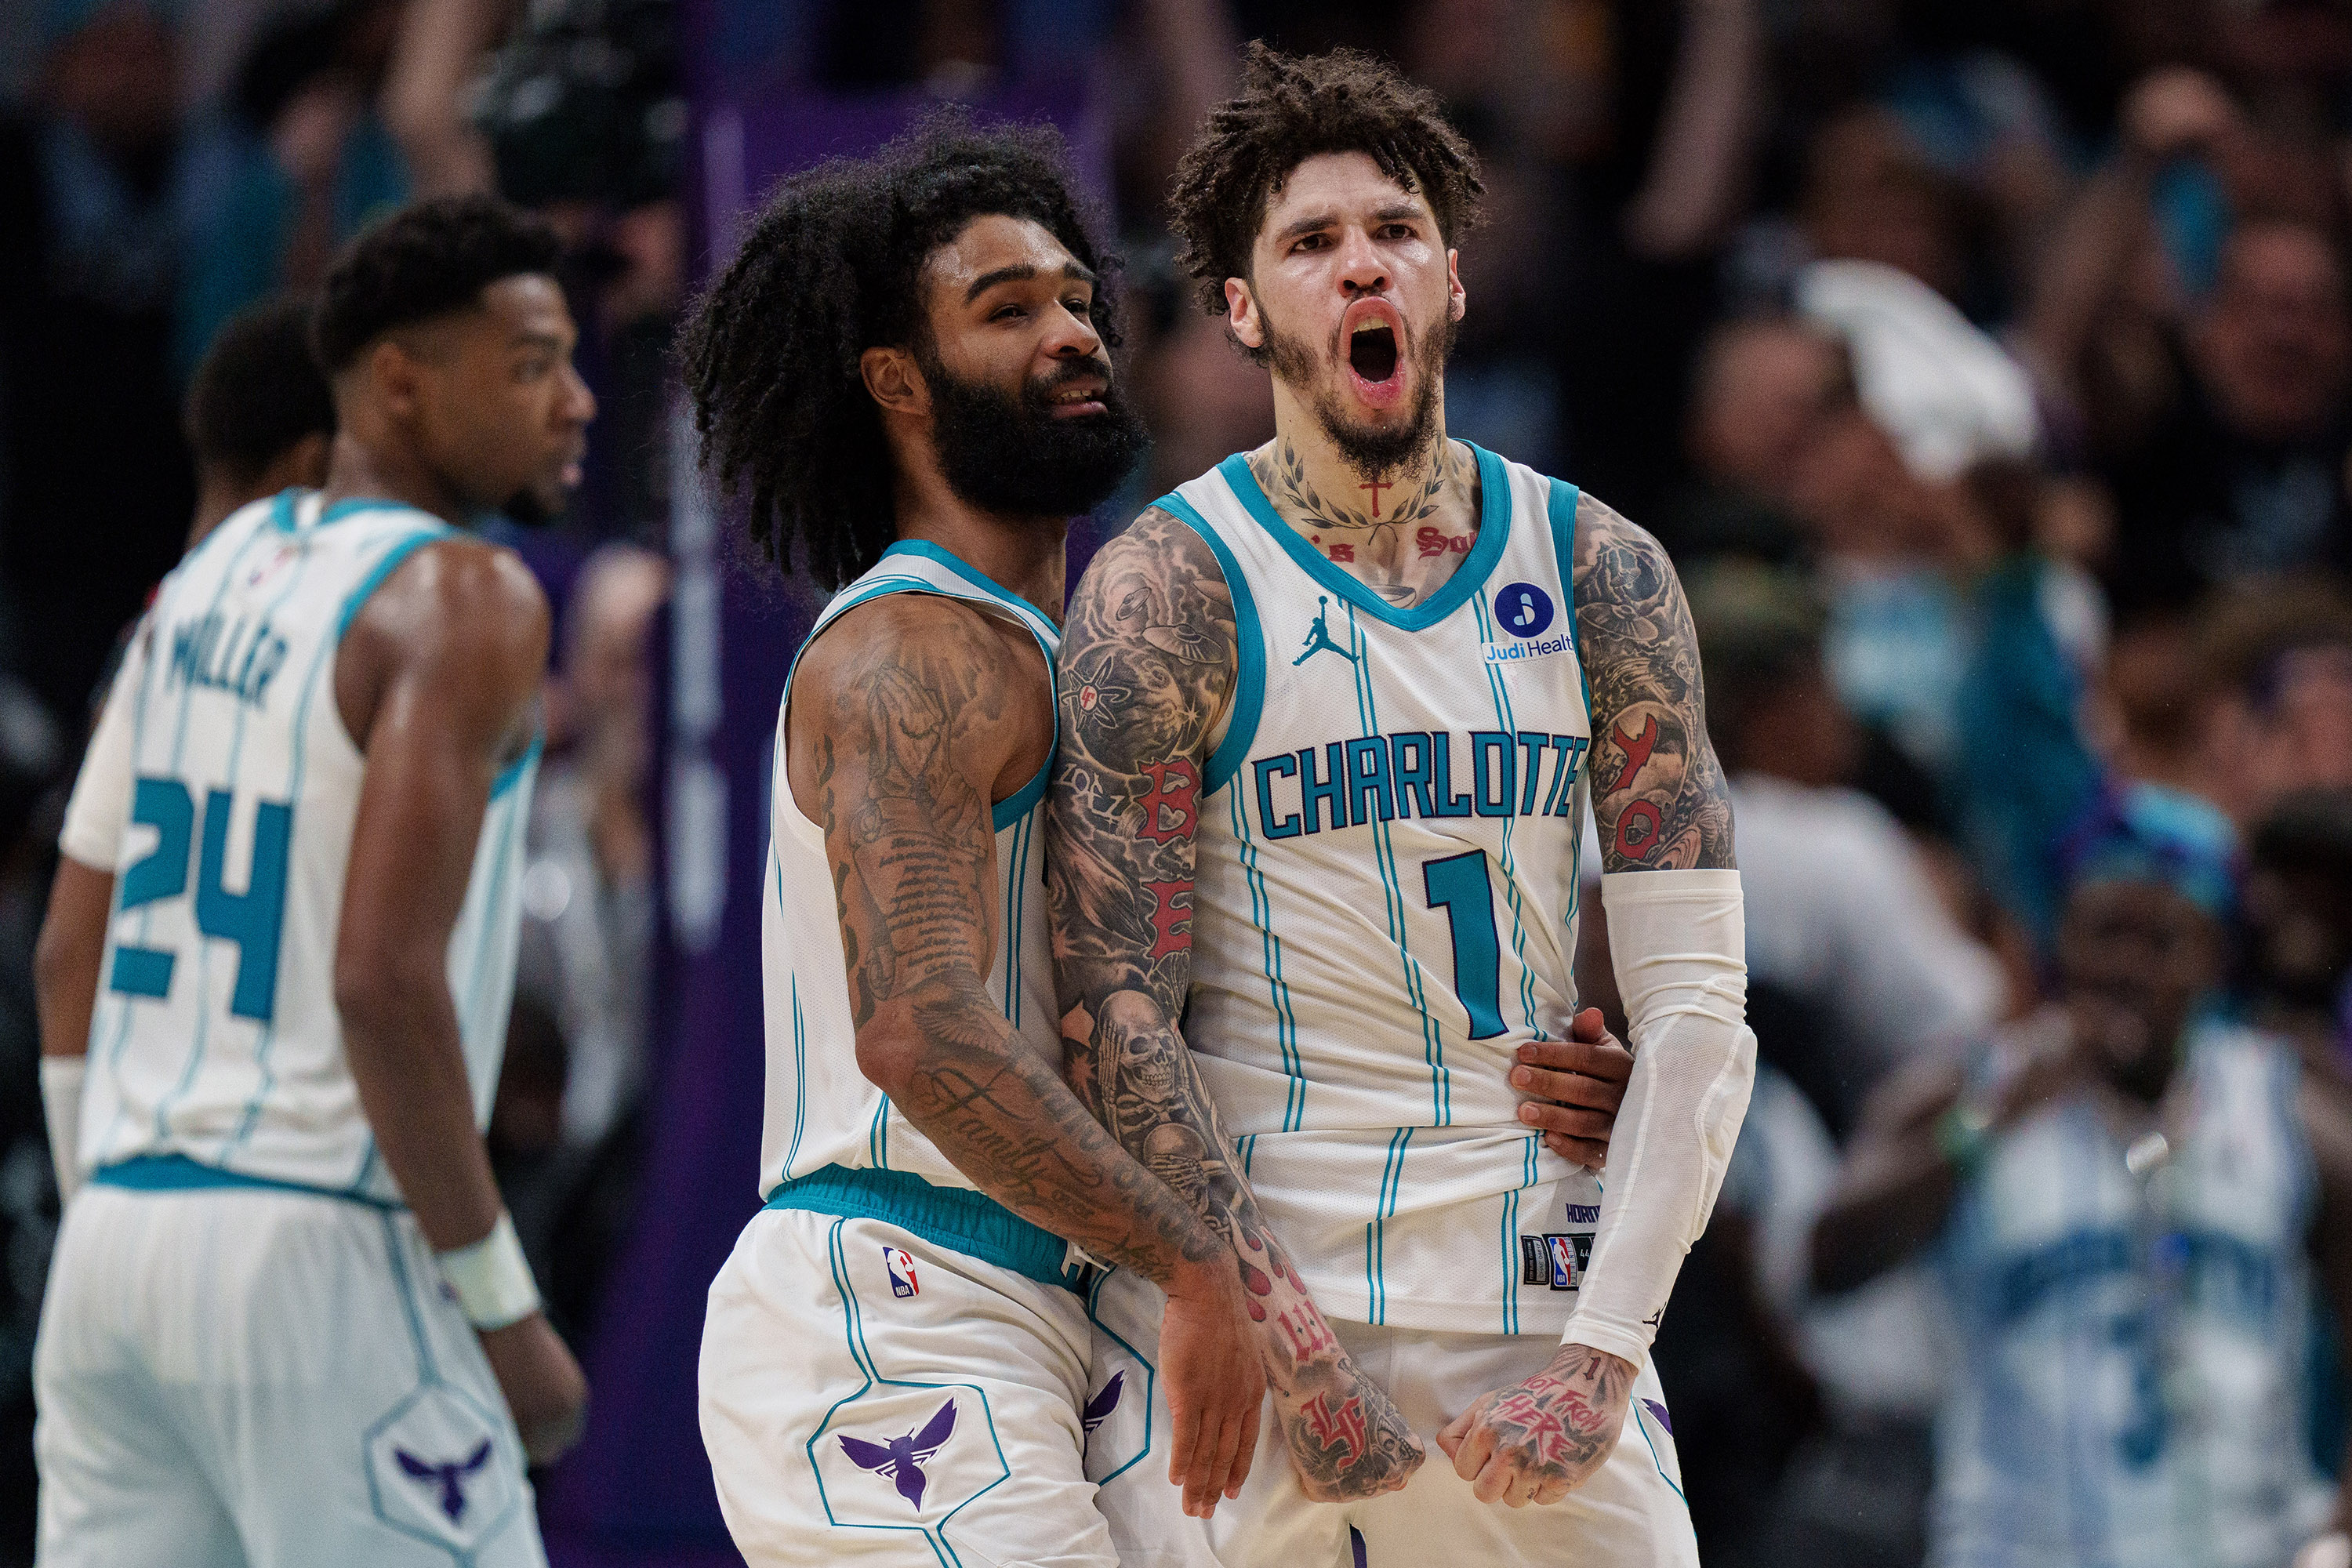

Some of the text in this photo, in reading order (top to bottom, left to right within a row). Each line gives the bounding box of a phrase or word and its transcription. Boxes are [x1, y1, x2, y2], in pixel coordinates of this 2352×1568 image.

[1486, 633, 1573, 661] Judi Healt
[1250, 730, 1591, 841] CHARLOTTE
[109, 775, 294, 1025] 24
[1422, 848, 1510, 1040] 1
[1565, 1203, 1601, 1224] HORN
[895, 1285, 910, 1297] NBA
[1556, 1274, 1566, 1284] NBA
